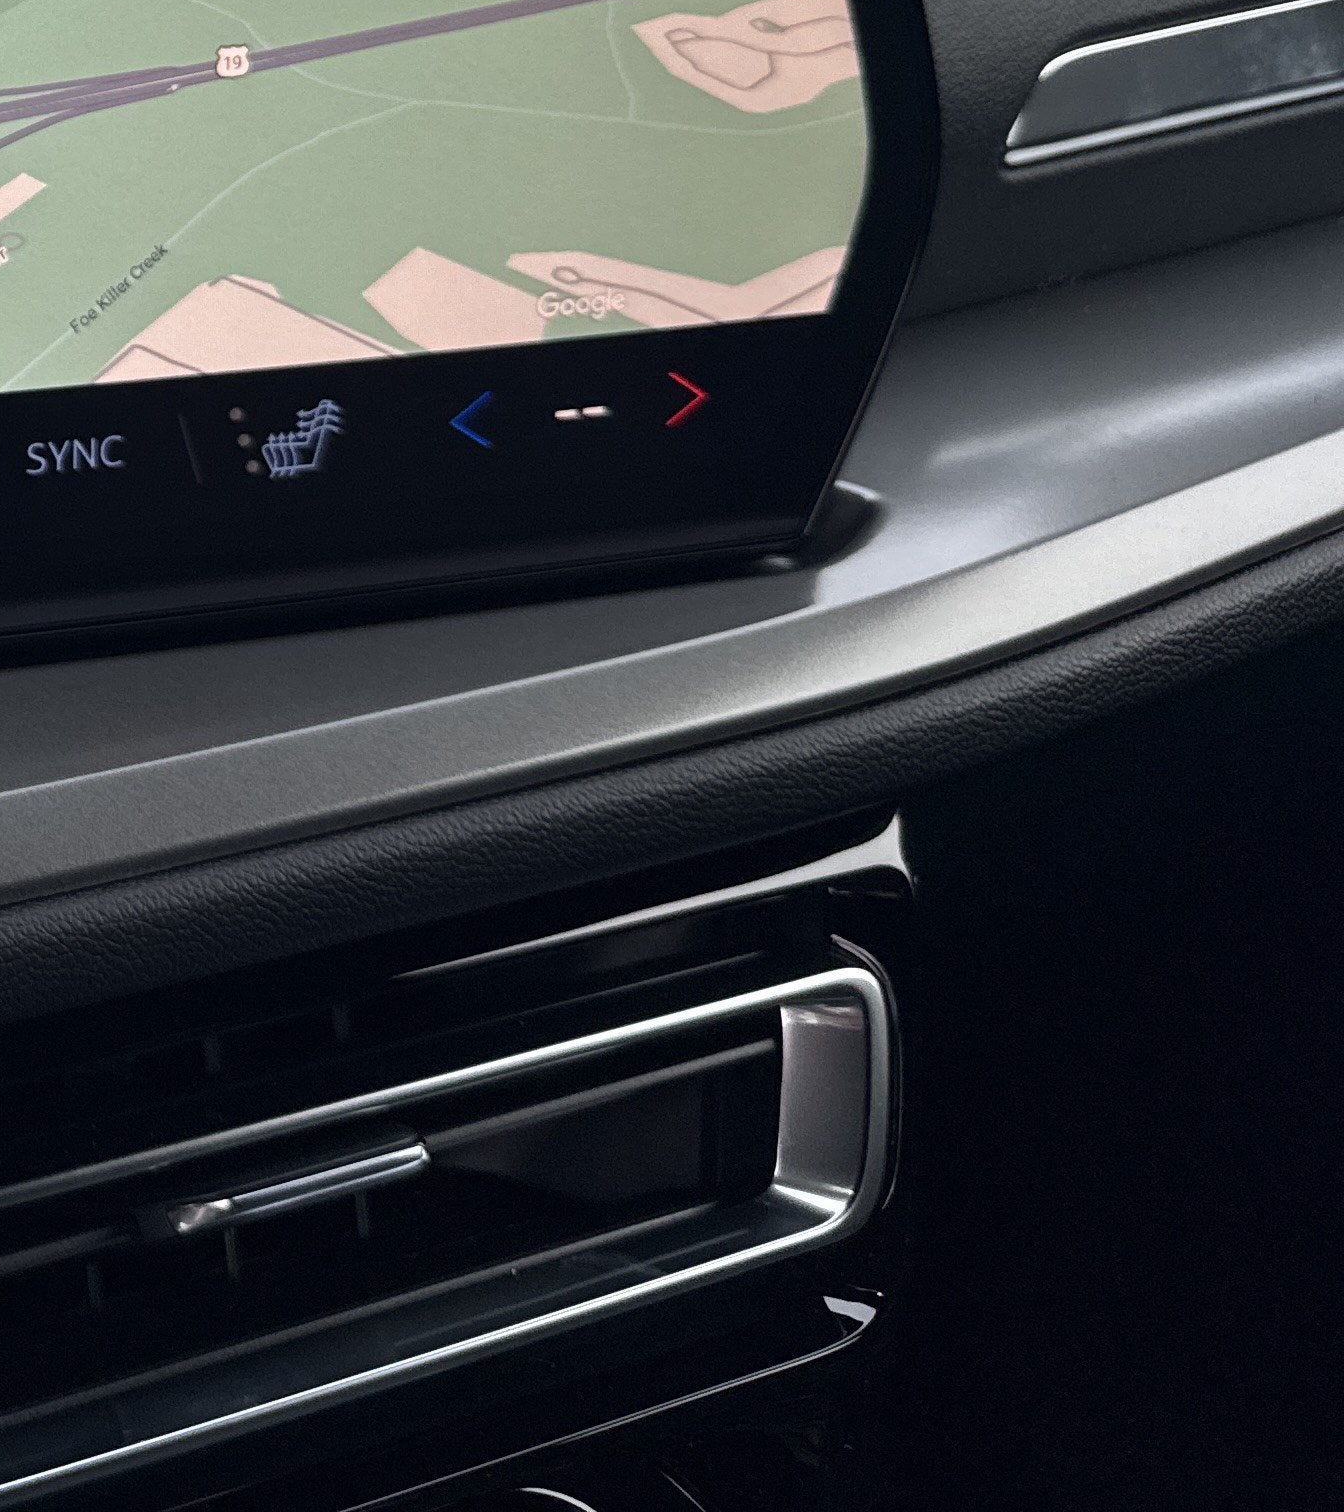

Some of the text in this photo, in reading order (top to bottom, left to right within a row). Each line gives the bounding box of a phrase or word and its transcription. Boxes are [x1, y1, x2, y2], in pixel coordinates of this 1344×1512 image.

[223, 53, 242, 72] 19
[69, 244, 168, 334] Foe Killer Creek
[537, 287, 626, 319] Google
[25, 434, 126, 478] SYNC
